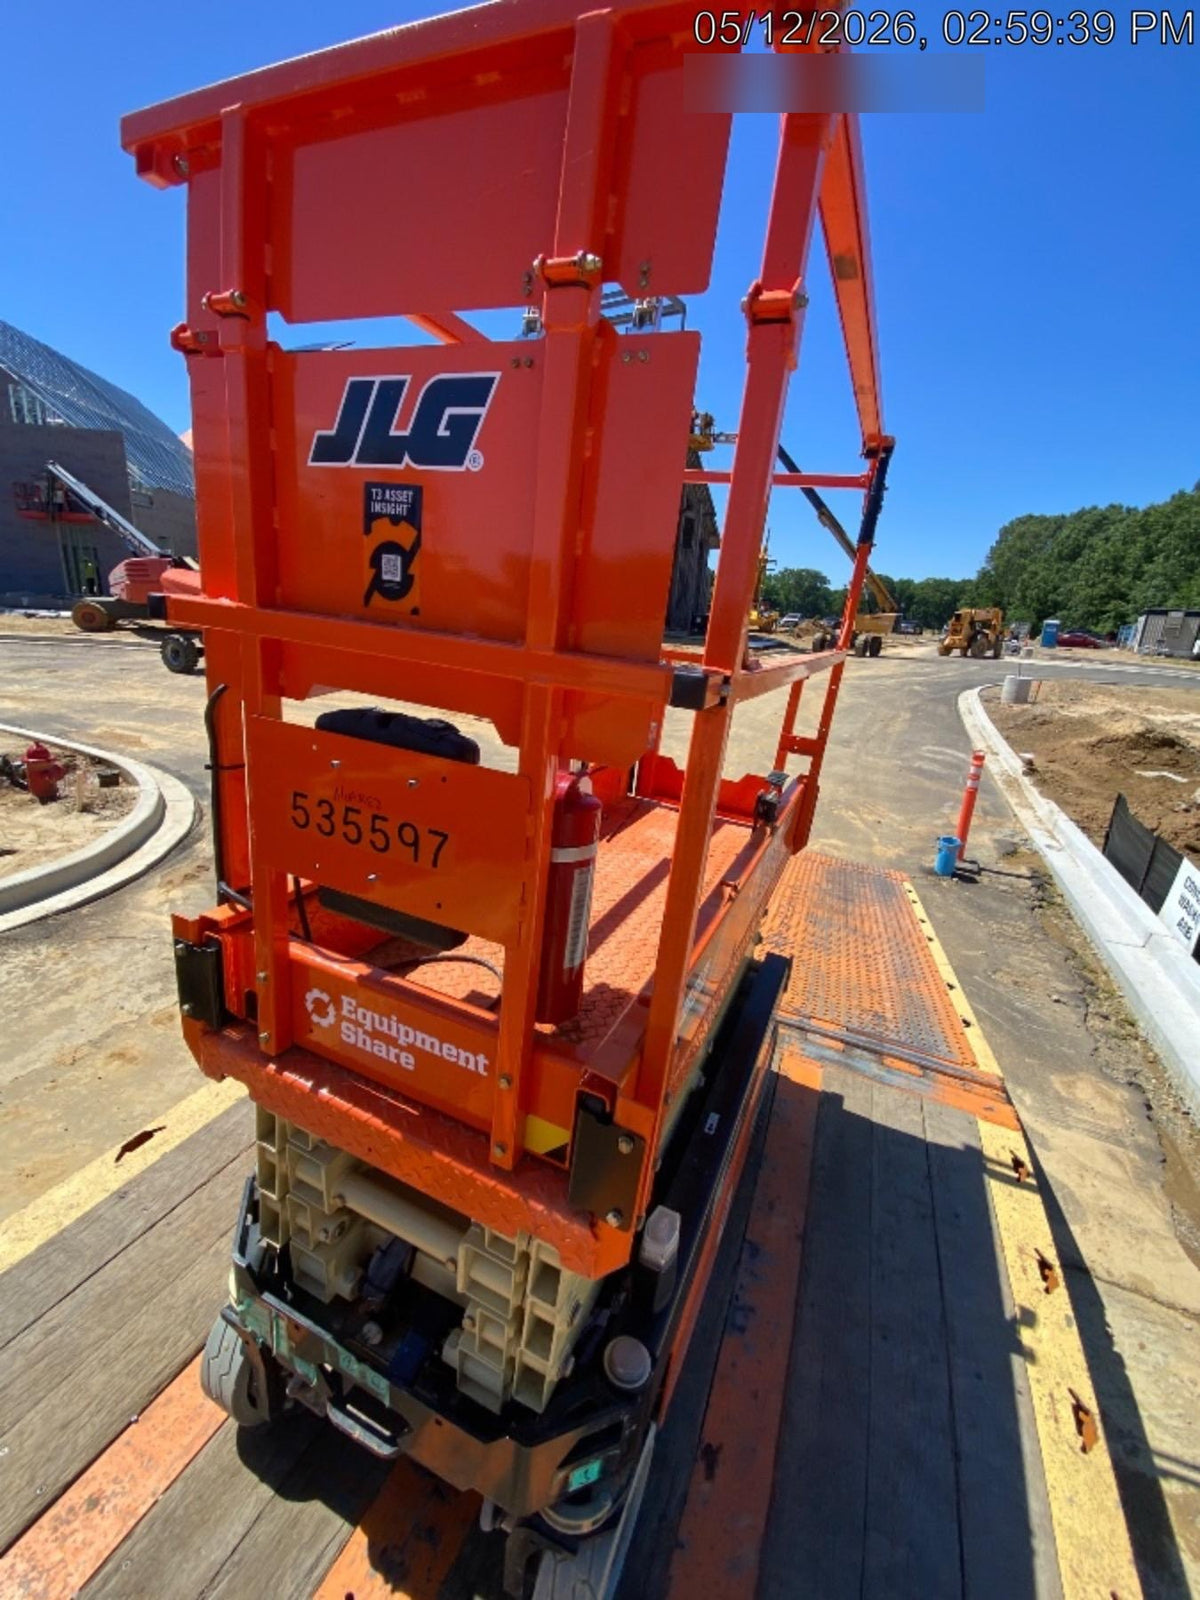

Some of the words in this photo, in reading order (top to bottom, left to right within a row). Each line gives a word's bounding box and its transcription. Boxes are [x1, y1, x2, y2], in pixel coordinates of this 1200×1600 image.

[371, 488, 383, 501] T3
[385, 489, 414, 503] ASSET
[291, 791, 449, 868] 535597
[341, 995, 490, 1076] Equipment
[341, 1021, 416, 1070] Share
